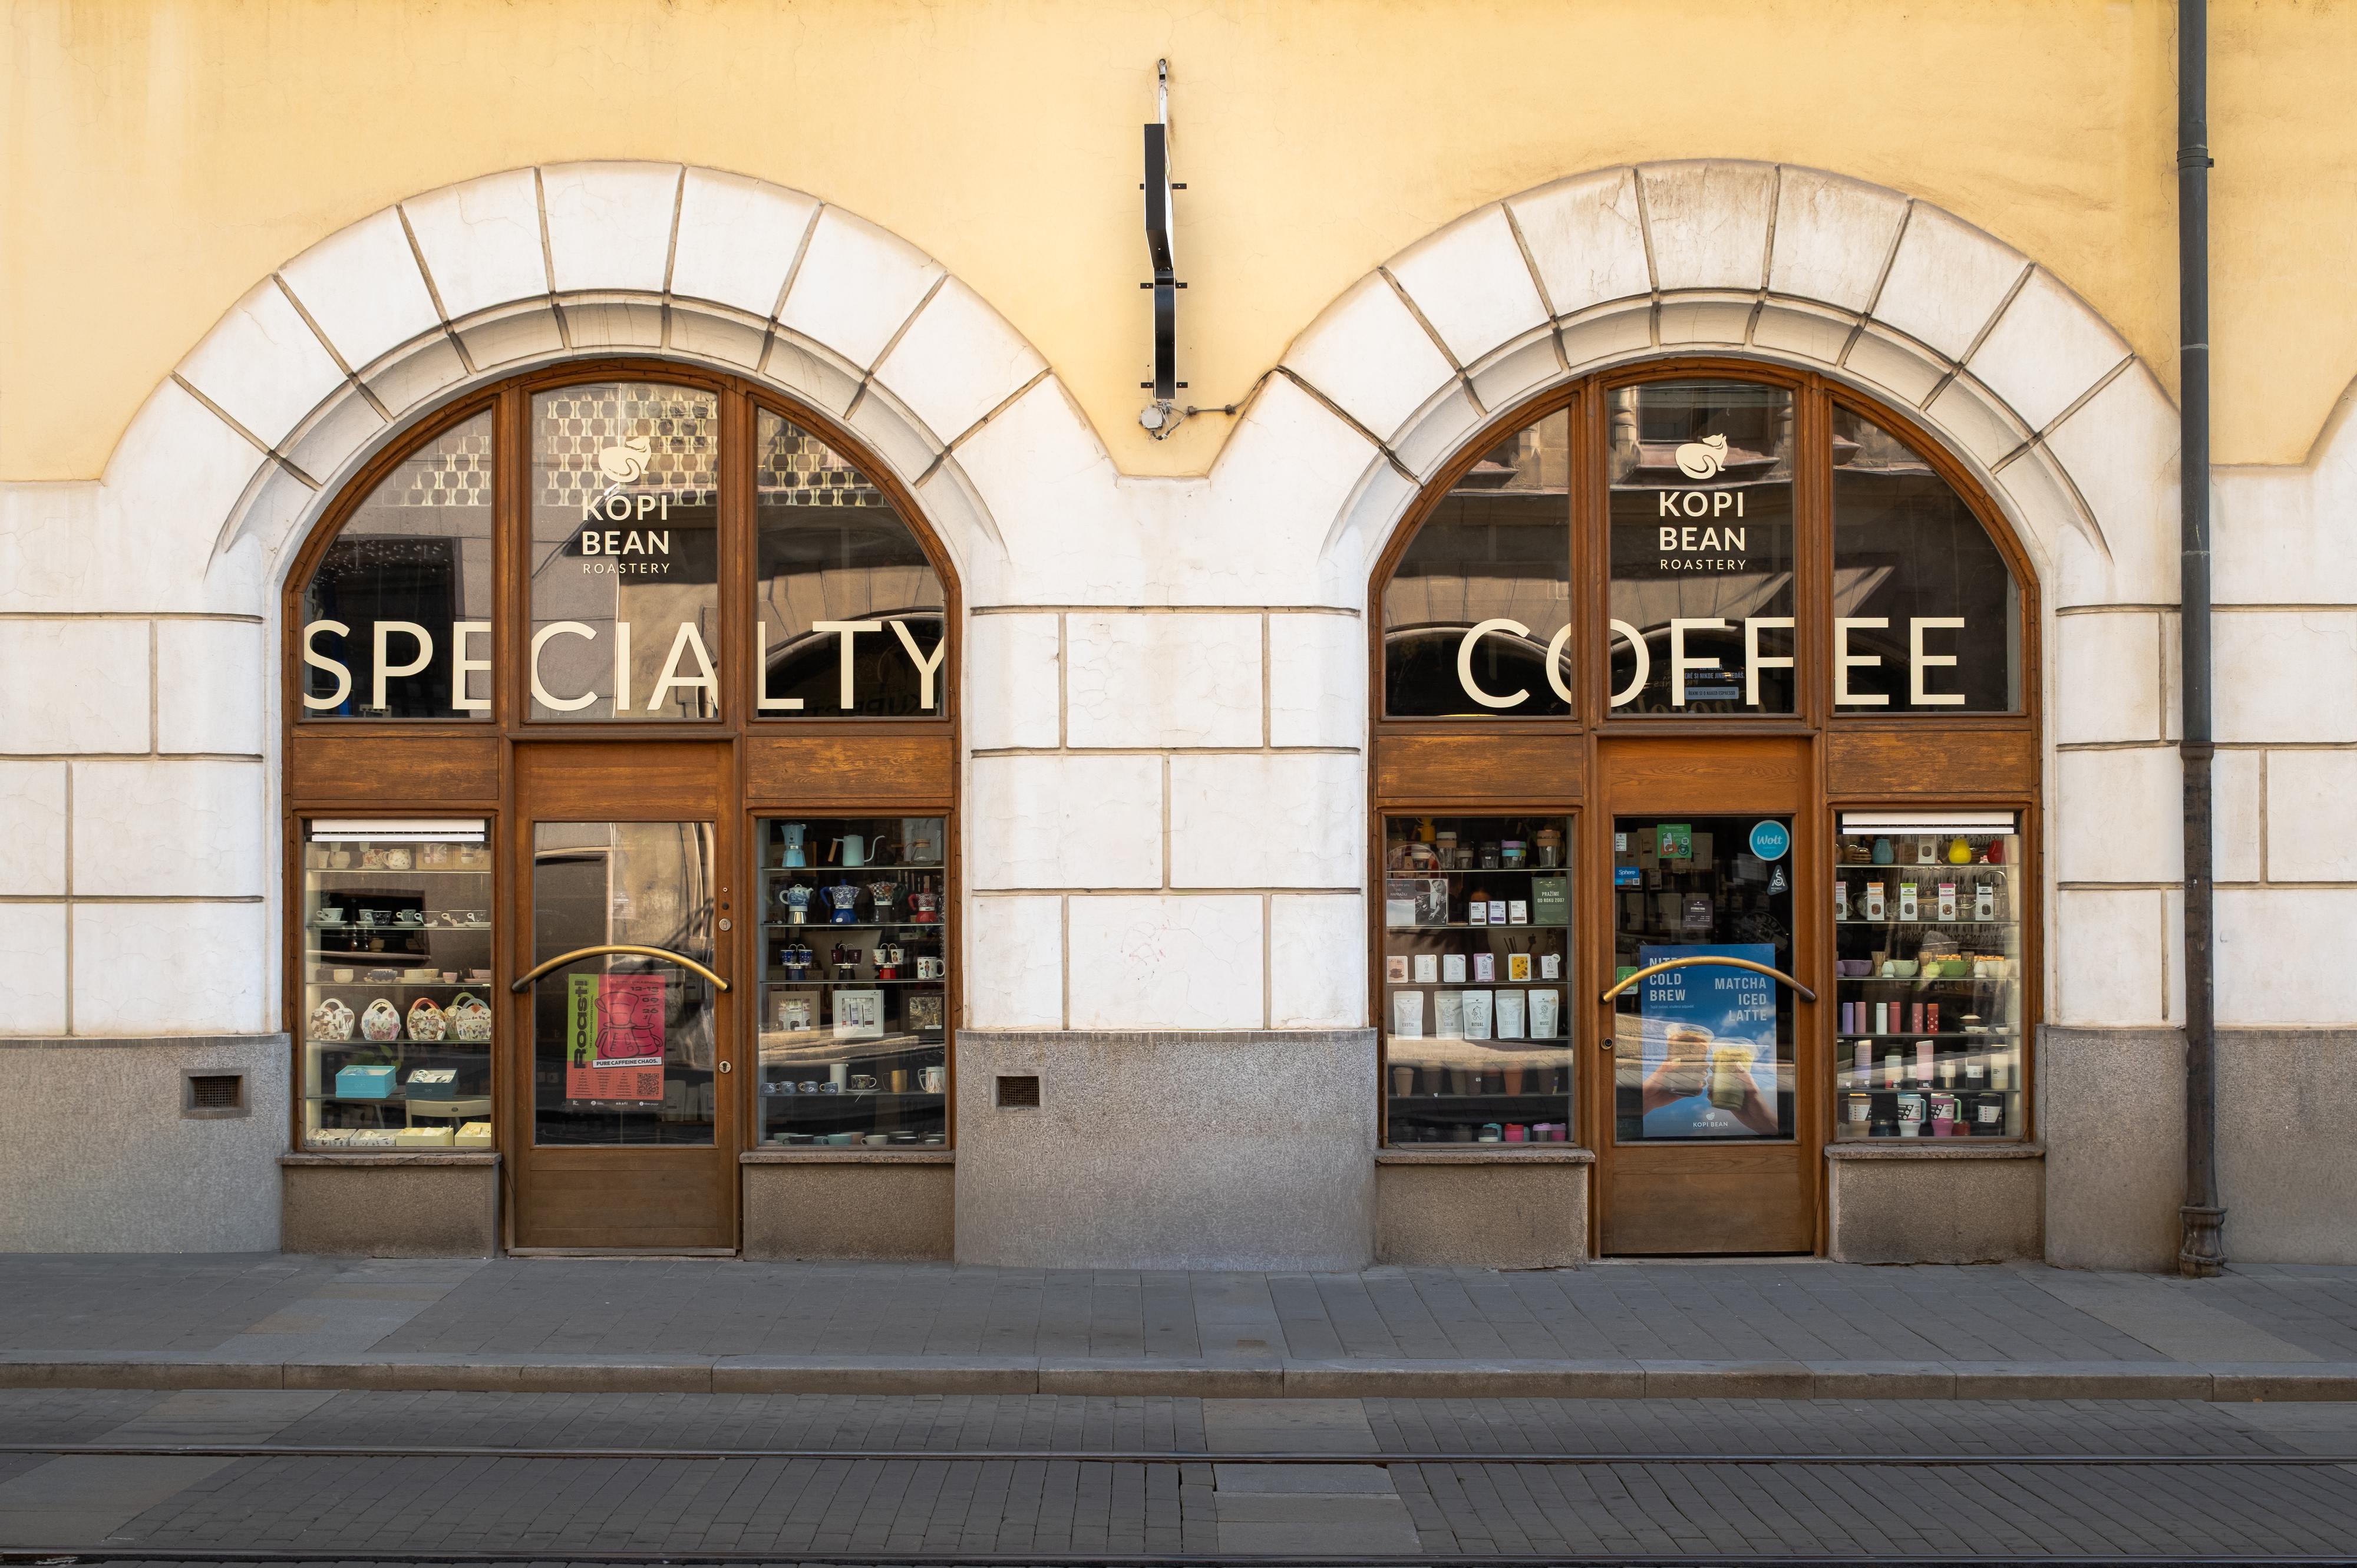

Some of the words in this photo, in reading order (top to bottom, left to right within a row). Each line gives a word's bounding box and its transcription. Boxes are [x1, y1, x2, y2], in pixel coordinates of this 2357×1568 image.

[582, 496, 668, 520] KOPI
[1659, 491, 1744, 517] KOPI
[583, 531, 669, 554] BEAN
[1659, 527, 1745, 551] BEAN
[583, 563, 670, 574] ROASTERY
[1661, 559, 1746, 570] ROASTERY
[303, 620, 945, 711] SPECIALTY
[1457, 618, 1965, 709] COFFEE
[1757, 835, 1782, 845] Wolt
[1650, 973, 1682, 986] COLD
[1715, 978, 1767, 990] MATCHA
[1650, 989, 1686, 1001] BREW
[1738, 993, 1767, 1005] ICED
[1729, 1009, 1767, 1021] LATTE
[574, 980, 589, 1069] Roast!
